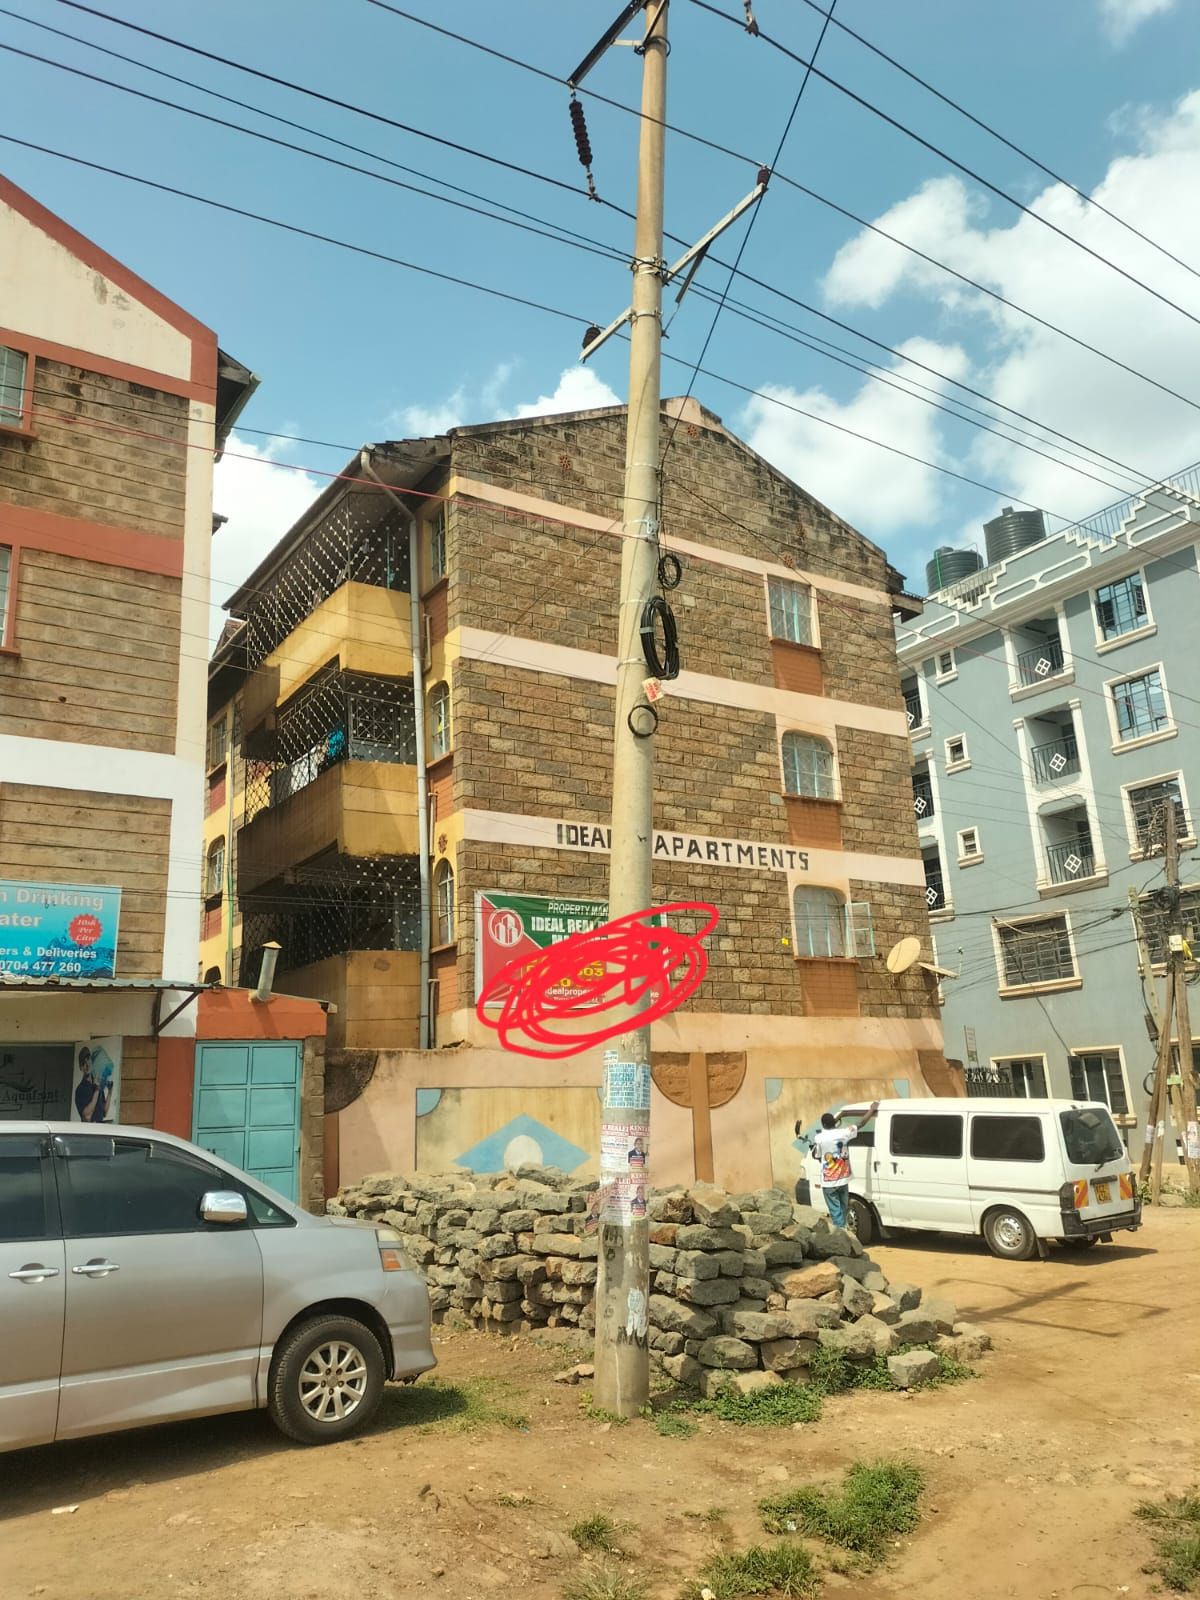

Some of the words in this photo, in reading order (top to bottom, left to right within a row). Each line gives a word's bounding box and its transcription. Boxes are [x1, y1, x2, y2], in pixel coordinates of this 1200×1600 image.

[654, 834, 809, 872] APARTMENTS
[16, 887, 104, 912] Drinking
[547, 902, 592, 916] PROPERTY
[531, 916, 566, 934] IDEAL
[23, 946, 32, 956] &
[37, 946, 97, 959] Deliveries
[32, 960, 56, 971] 477
[59, 962, 82, 972] 260
